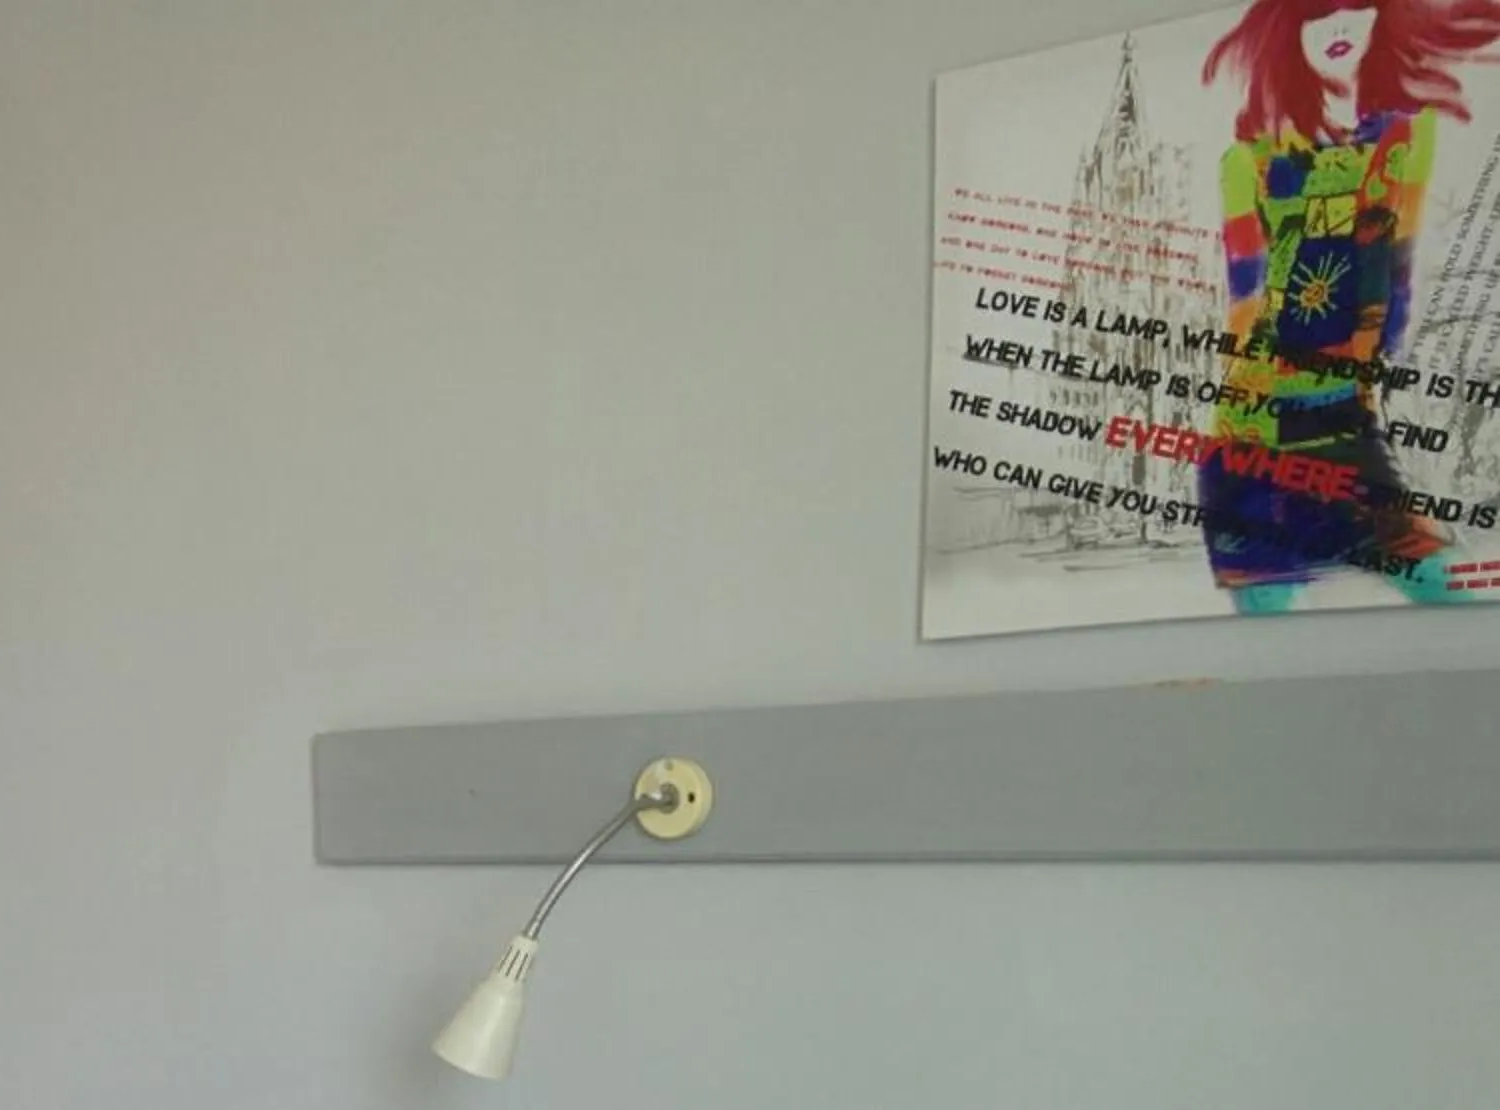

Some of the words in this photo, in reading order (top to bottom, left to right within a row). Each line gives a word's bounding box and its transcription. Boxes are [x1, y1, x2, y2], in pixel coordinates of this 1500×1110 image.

[976, 287, 1040, 319] LOVE
[1043, 300, 1067, 323] IS
[1071, 307, 1087, 329] A
[1095, 310, 1170, 348] LAMP,
[1182, 324, 1260, 361] WHILE
[1426, 374, 1454, 398] IS
[949, 390, 992, 418] THE
[996, 401, 1102, 442] SHADOW
[967, 334, 1034, 368] WHEN
[1040, 350, 1086, 378] THE
[1089, 360, 1162, 391] LAMP
[1166, 375, 1191, 398] IS
[1387, 421, 1449, 453] FIND
[934, 446, 987, 476] WHO
[993, 460, 1043, 489] CAN
[1050, 474, 1103, 505] GIVE
[1107, 483, 1156, 515] YOU
[1468, 504, 1497, 529] IS
